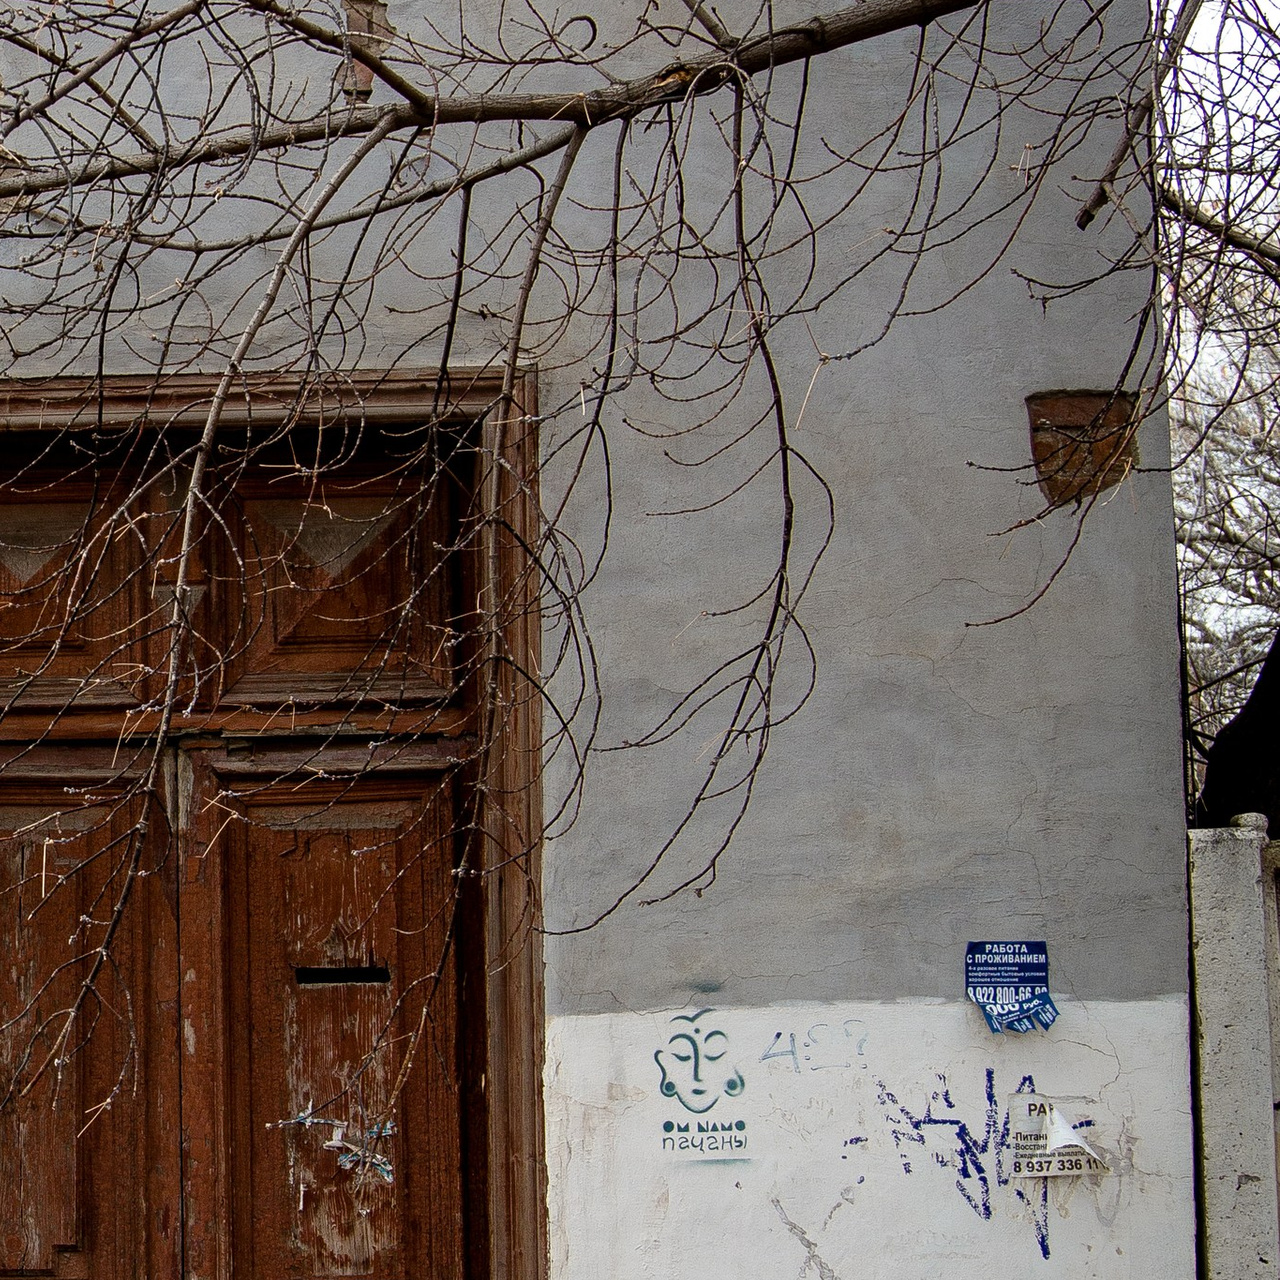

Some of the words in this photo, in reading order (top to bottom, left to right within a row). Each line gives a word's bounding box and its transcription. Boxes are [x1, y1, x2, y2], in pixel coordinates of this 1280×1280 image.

[985, 944, 1028, 953] РАБОТА
[966, 954, 973, 963] С
[975, 954, 1046, 964] ПРОЖИВАНИЕМ
[975, 986, 996, 1004] 922
[1013, 1161, 1022, 1173] 8
[1026, 1160, 1052, 1173] 937
[1057, 1159, 1083, 1171] 336
